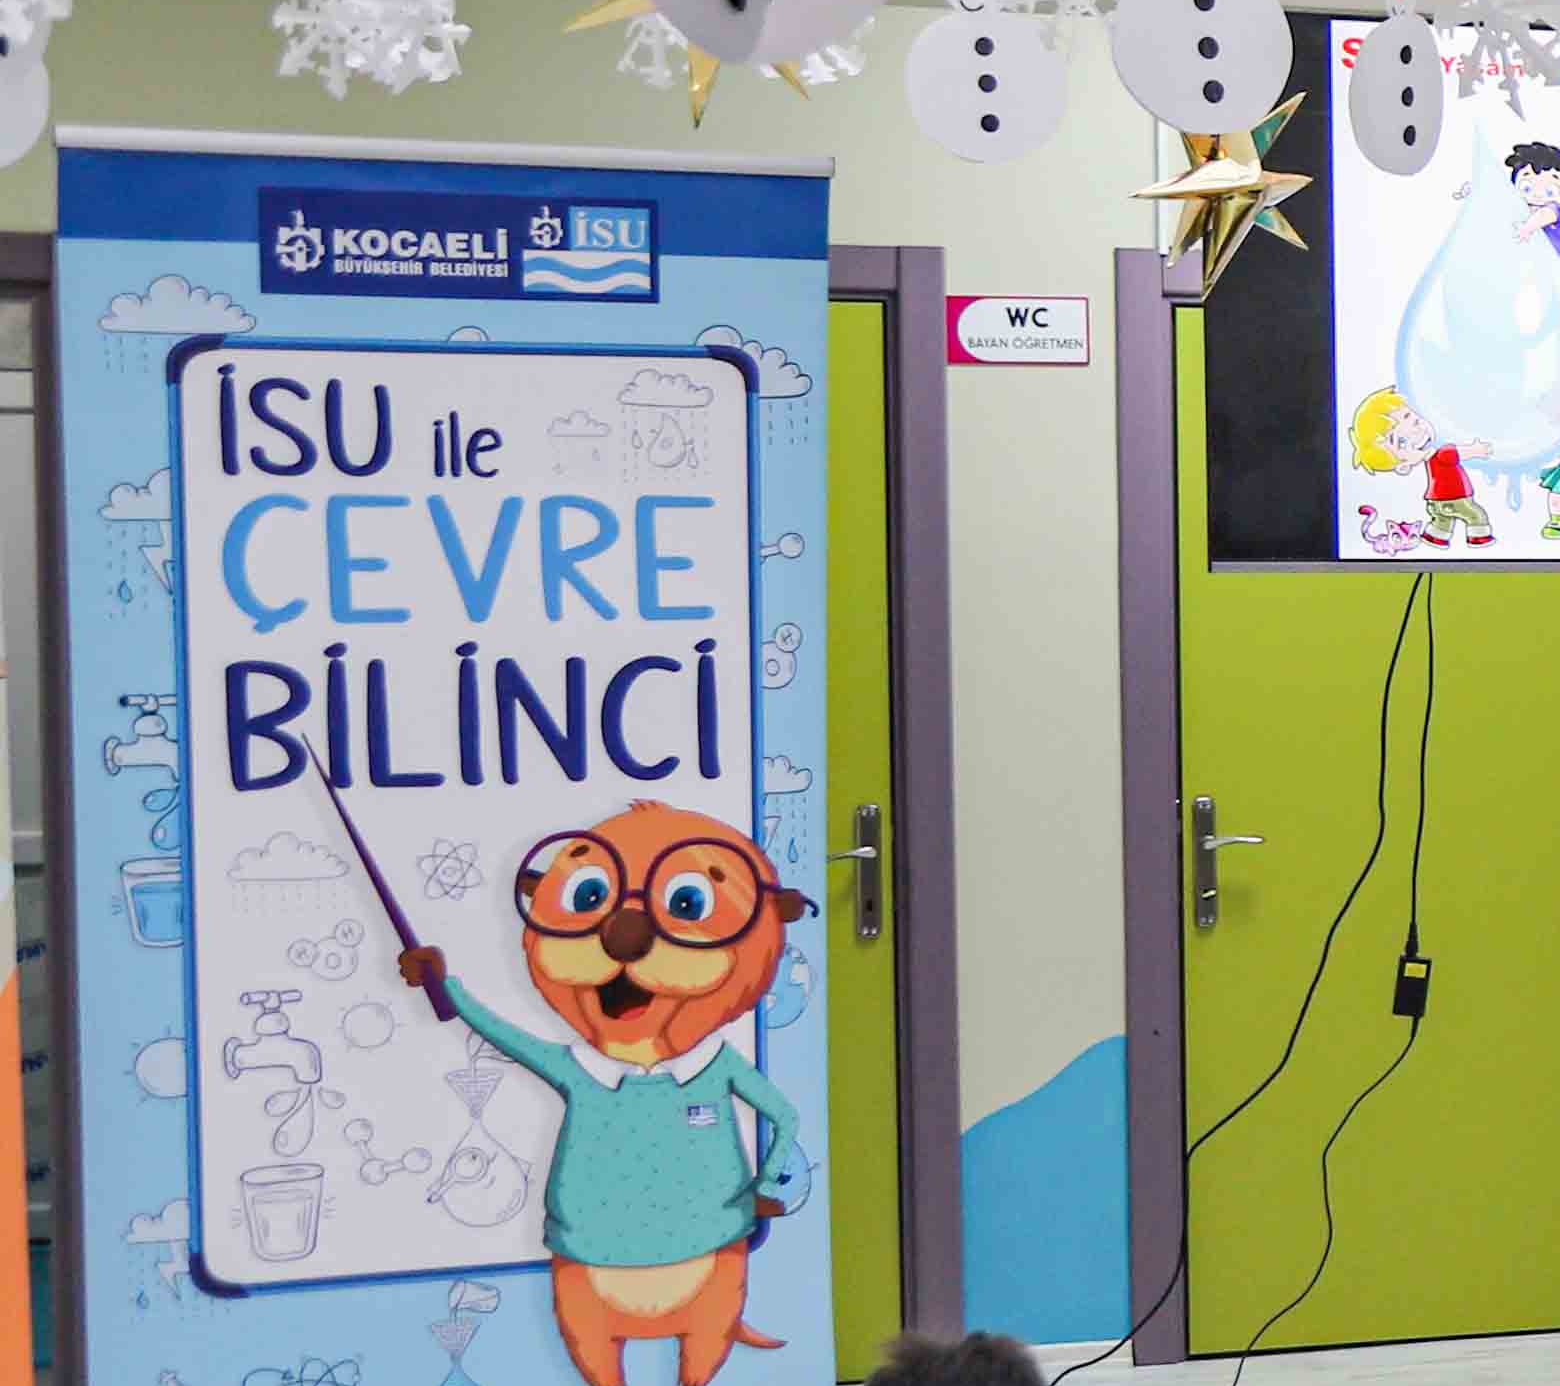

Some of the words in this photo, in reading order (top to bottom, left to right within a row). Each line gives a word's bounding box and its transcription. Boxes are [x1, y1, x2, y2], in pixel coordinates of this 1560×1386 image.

[333, 228, 508, 260] KOCAELİ
[576, 210, 646, 248] İSU
[1005, 307, 1048, 328] WC
[967, 337, 1009, 350] BAYAN
[217, 363, 393, 477] İSU
[432, 410, 503, 478] ile
[221, 494, 715, 634] ÇEVRE
[225, 638, 722, 792] BİLİNCİ
